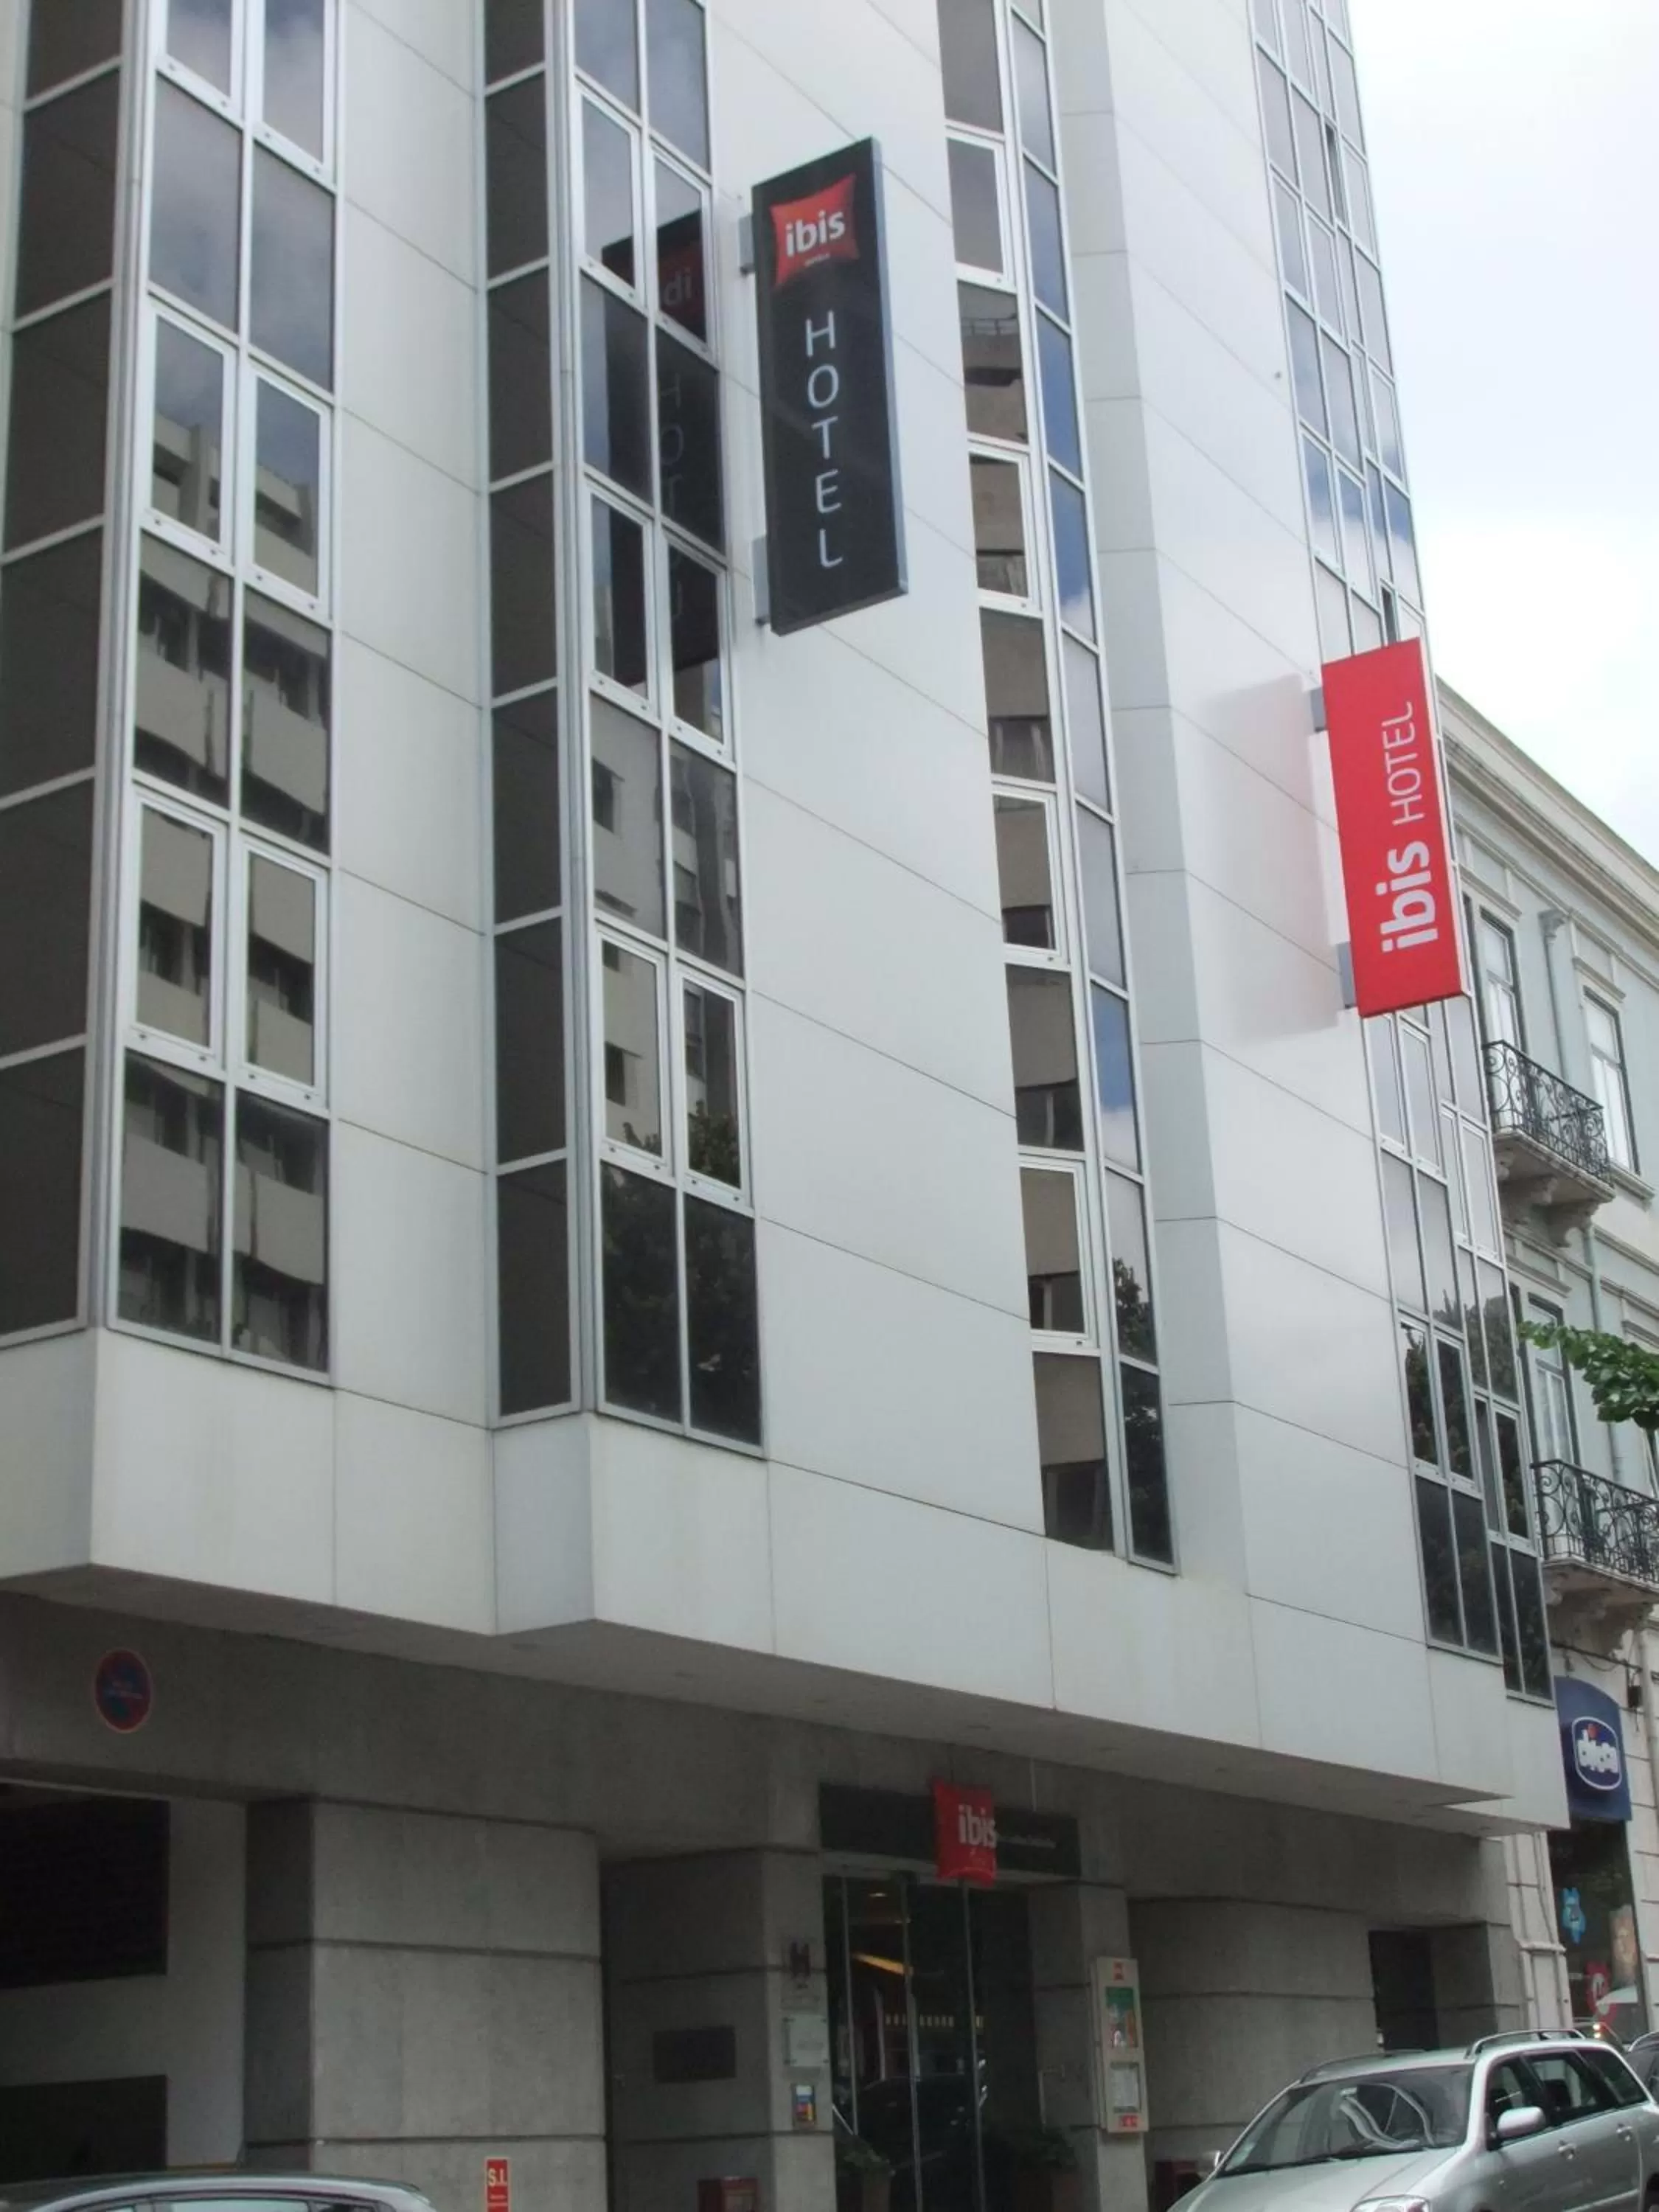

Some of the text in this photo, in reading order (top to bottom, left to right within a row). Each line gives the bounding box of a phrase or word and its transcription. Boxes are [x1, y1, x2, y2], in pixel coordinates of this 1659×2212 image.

[785, 210, 845, 257] ibis
[806, 310, 842, 568] HOTEL
[1376, 701, 1439, 953] ibis HOTEL
[959, 1804, 997, 1848] ibis
